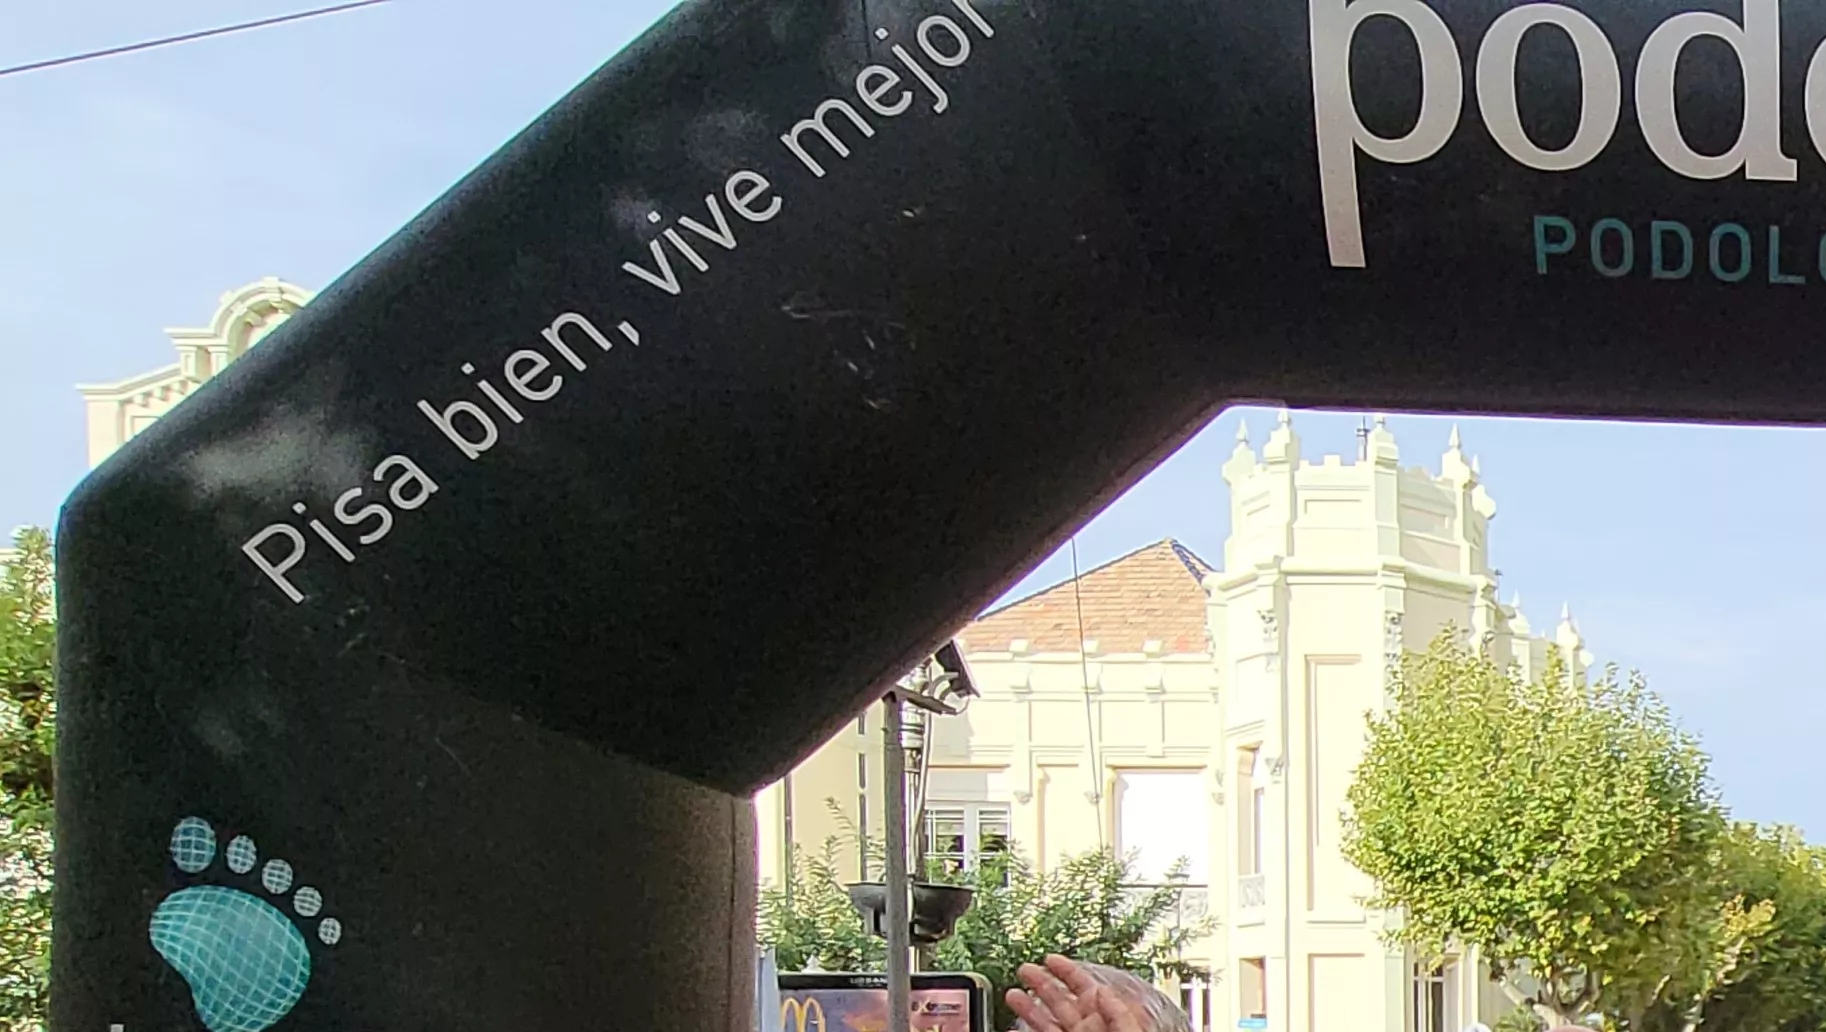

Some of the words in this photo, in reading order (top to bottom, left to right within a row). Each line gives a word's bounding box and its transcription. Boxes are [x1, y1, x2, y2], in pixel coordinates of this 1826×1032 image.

[242, 448, 439, 603] Pisa
[418, 309, 640, 460] bien,
[622, 167, 782, 297] vive
